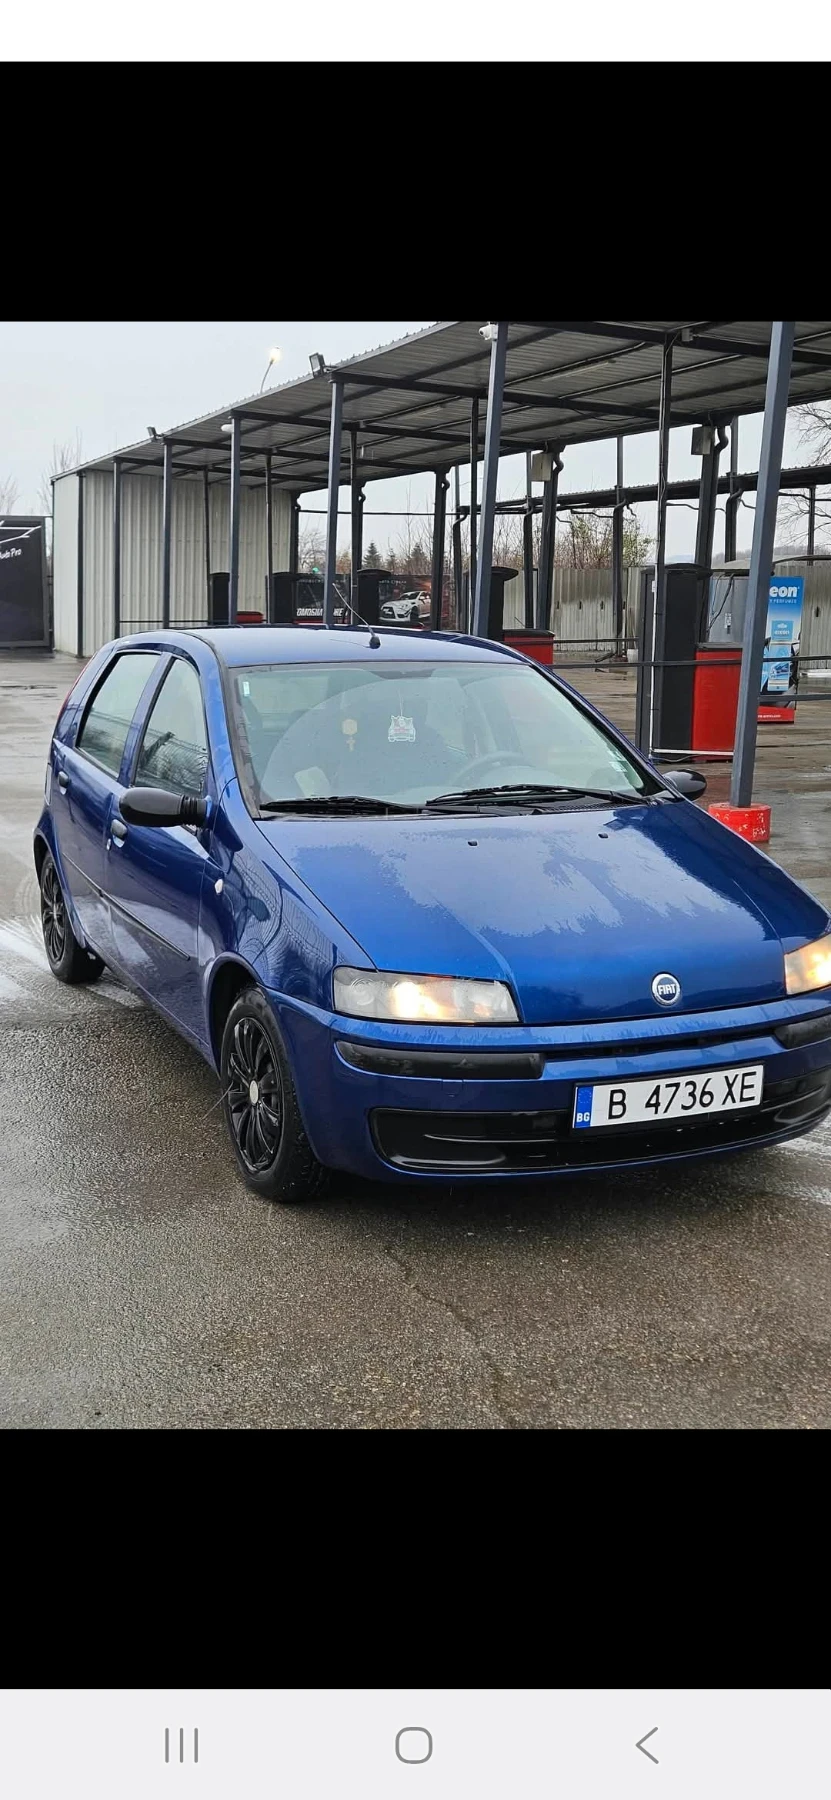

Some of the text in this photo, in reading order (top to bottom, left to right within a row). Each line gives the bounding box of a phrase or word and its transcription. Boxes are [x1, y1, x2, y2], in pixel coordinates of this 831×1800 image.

[769, 586, 798, 598] eon
[657, 983, 676, 995] FIAT
[608, 1071, 757, 1120] B 4736 XE
[576, 1112, 591, 1123] BG
